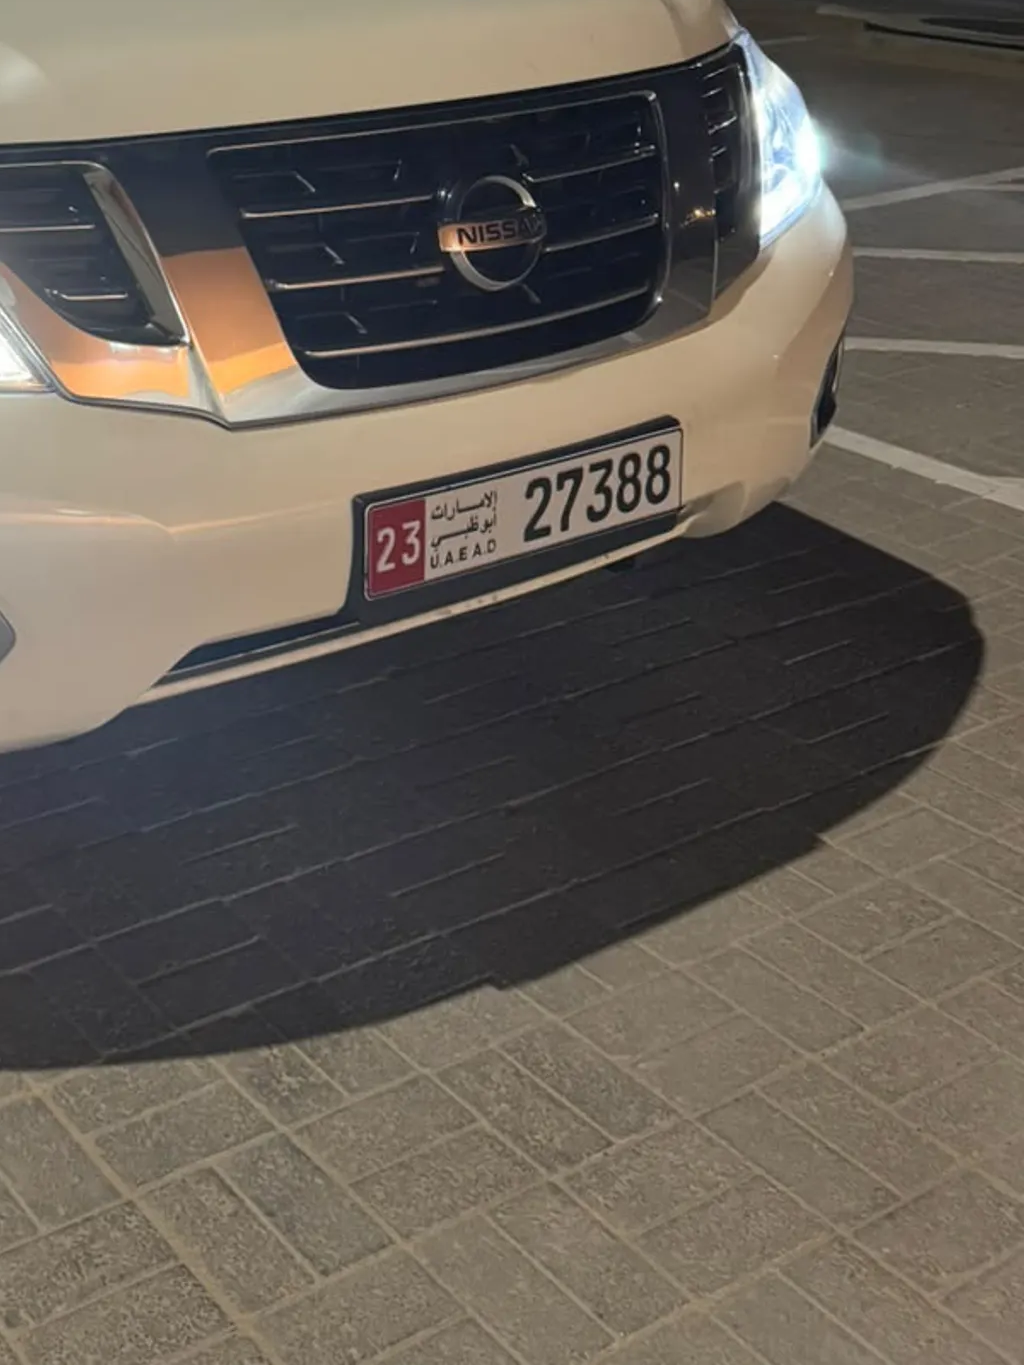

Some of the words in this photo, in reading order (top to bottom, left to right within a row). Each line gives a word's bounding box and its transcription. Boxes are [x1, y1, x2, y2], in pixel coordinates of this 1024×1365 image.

[457, 217, 544, 245] NISSAN
[523, 444, 672, 542] 27388
[376, 520, 420, 573] 23
